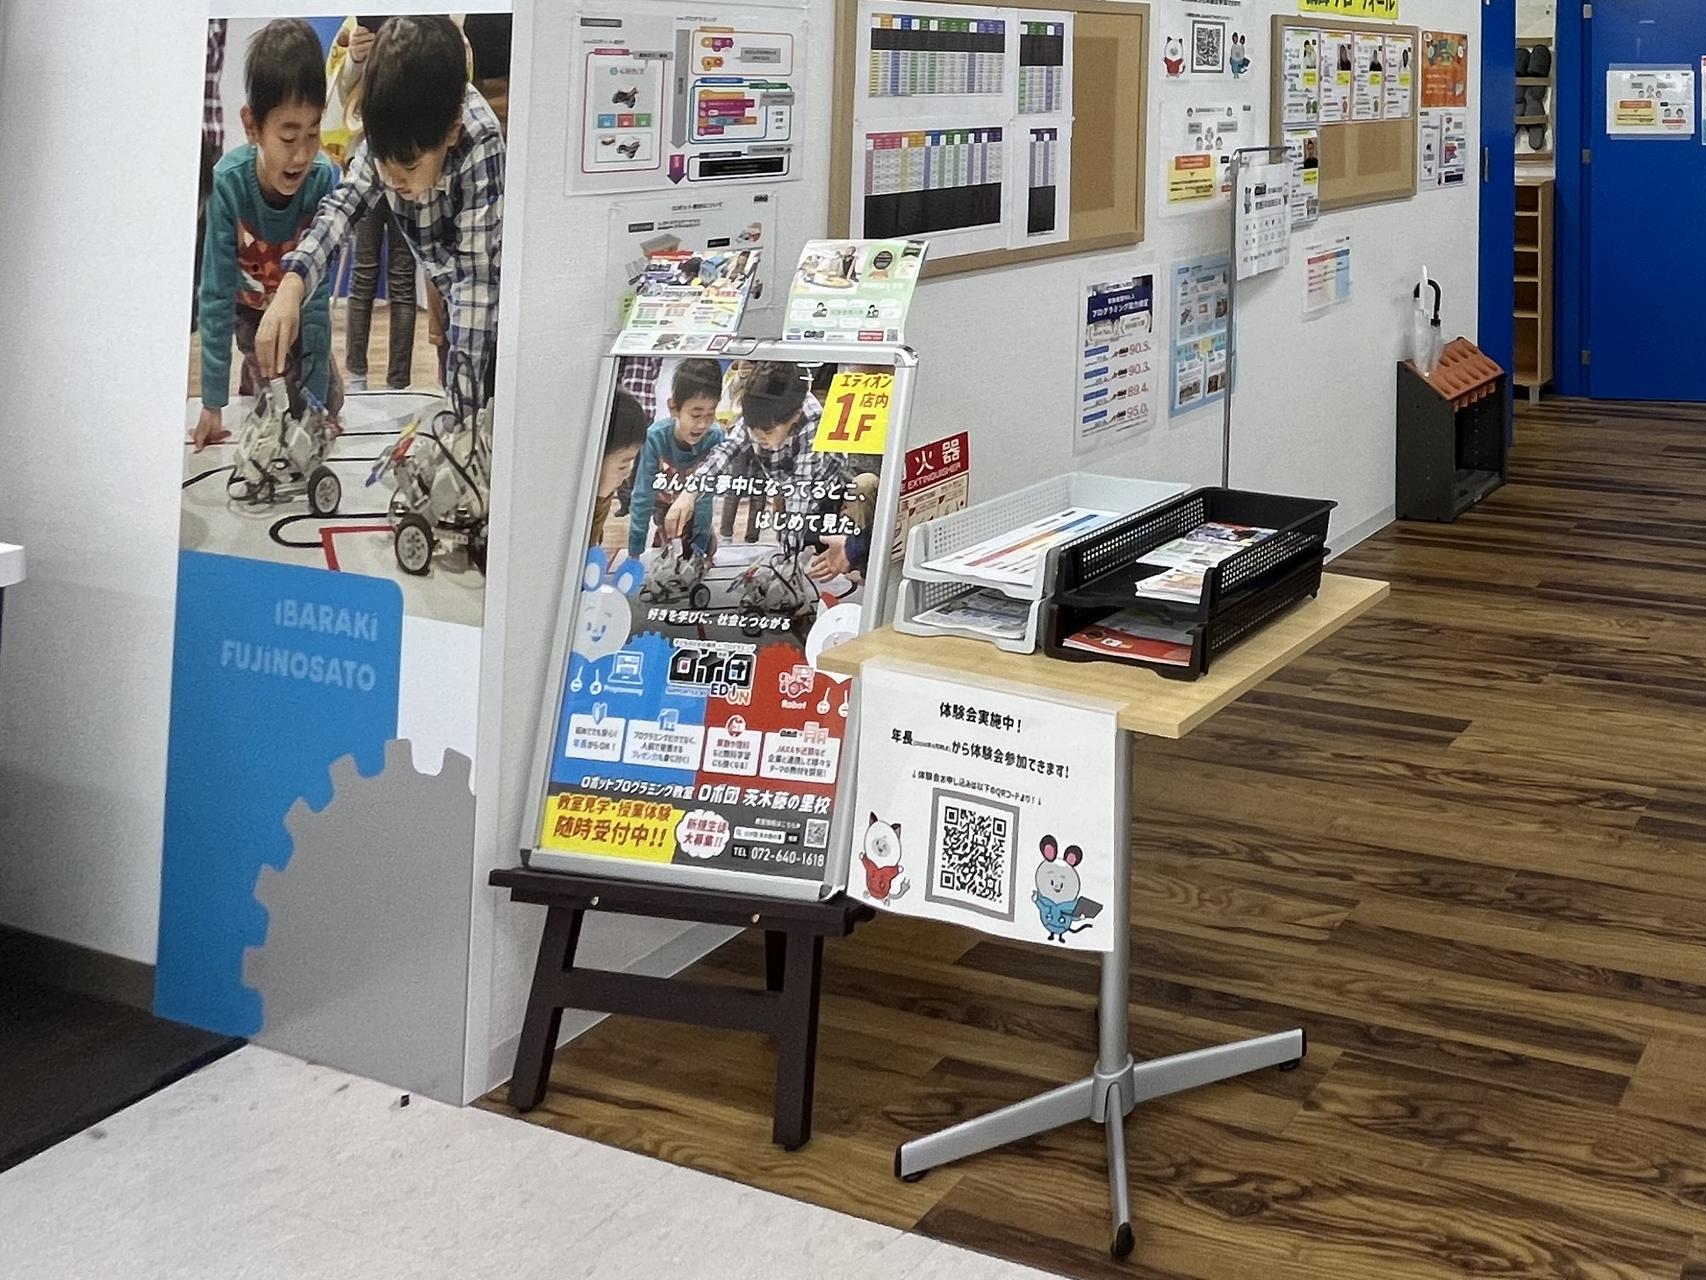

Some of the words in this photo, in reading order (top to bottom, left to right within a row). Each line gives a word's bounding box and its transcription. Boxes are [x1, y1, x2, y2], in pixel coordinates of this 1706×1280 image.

[839, 373, 893, 388] エディオン
[860, 392, 889, 410] 店内
[827, 392, 876, 442] 1F
[903, 438, 961, 481] 火器
[652, 472, 867, 503] あんなに夢中になってるとこ、
[907, 461, 962, 491] EXTINGUISHER
[754, 511, 862, 536] はじめて見た。
[940, 702, 1022, 733] 体験会実施中!
[554, 815, 667, 848] 随時受付中!!
[733, 846, 747, 857] TEL
[750, 846, 826, 868] 072-640-1618
